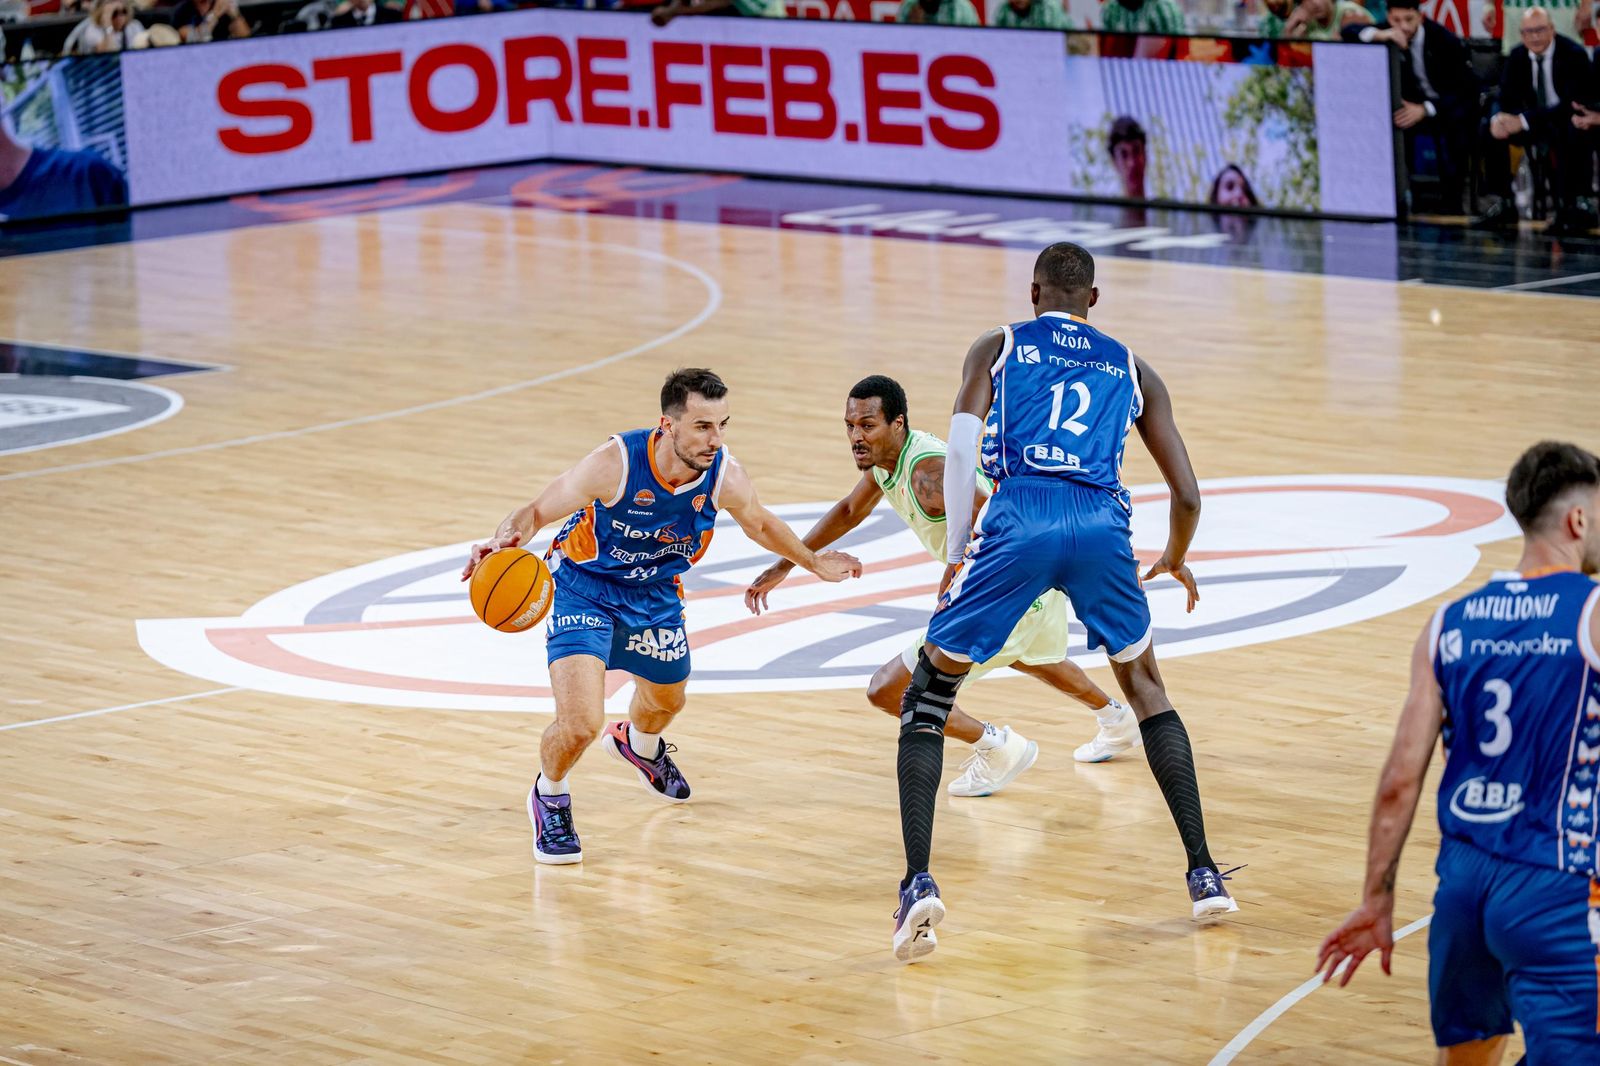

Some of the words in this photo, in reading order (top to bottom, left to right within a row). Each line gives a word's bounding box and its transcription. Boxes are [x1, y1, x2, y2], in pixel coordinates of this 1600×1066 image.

[216, 35, 1001, 153] STORE.FEB.ES
[1052, 331, 1092, 351] NZOSA
[1048, 381, 1092, 437] 12
[625, 640, 687, 662] JOHNS
[1479, 678, 1513, 757] 3
